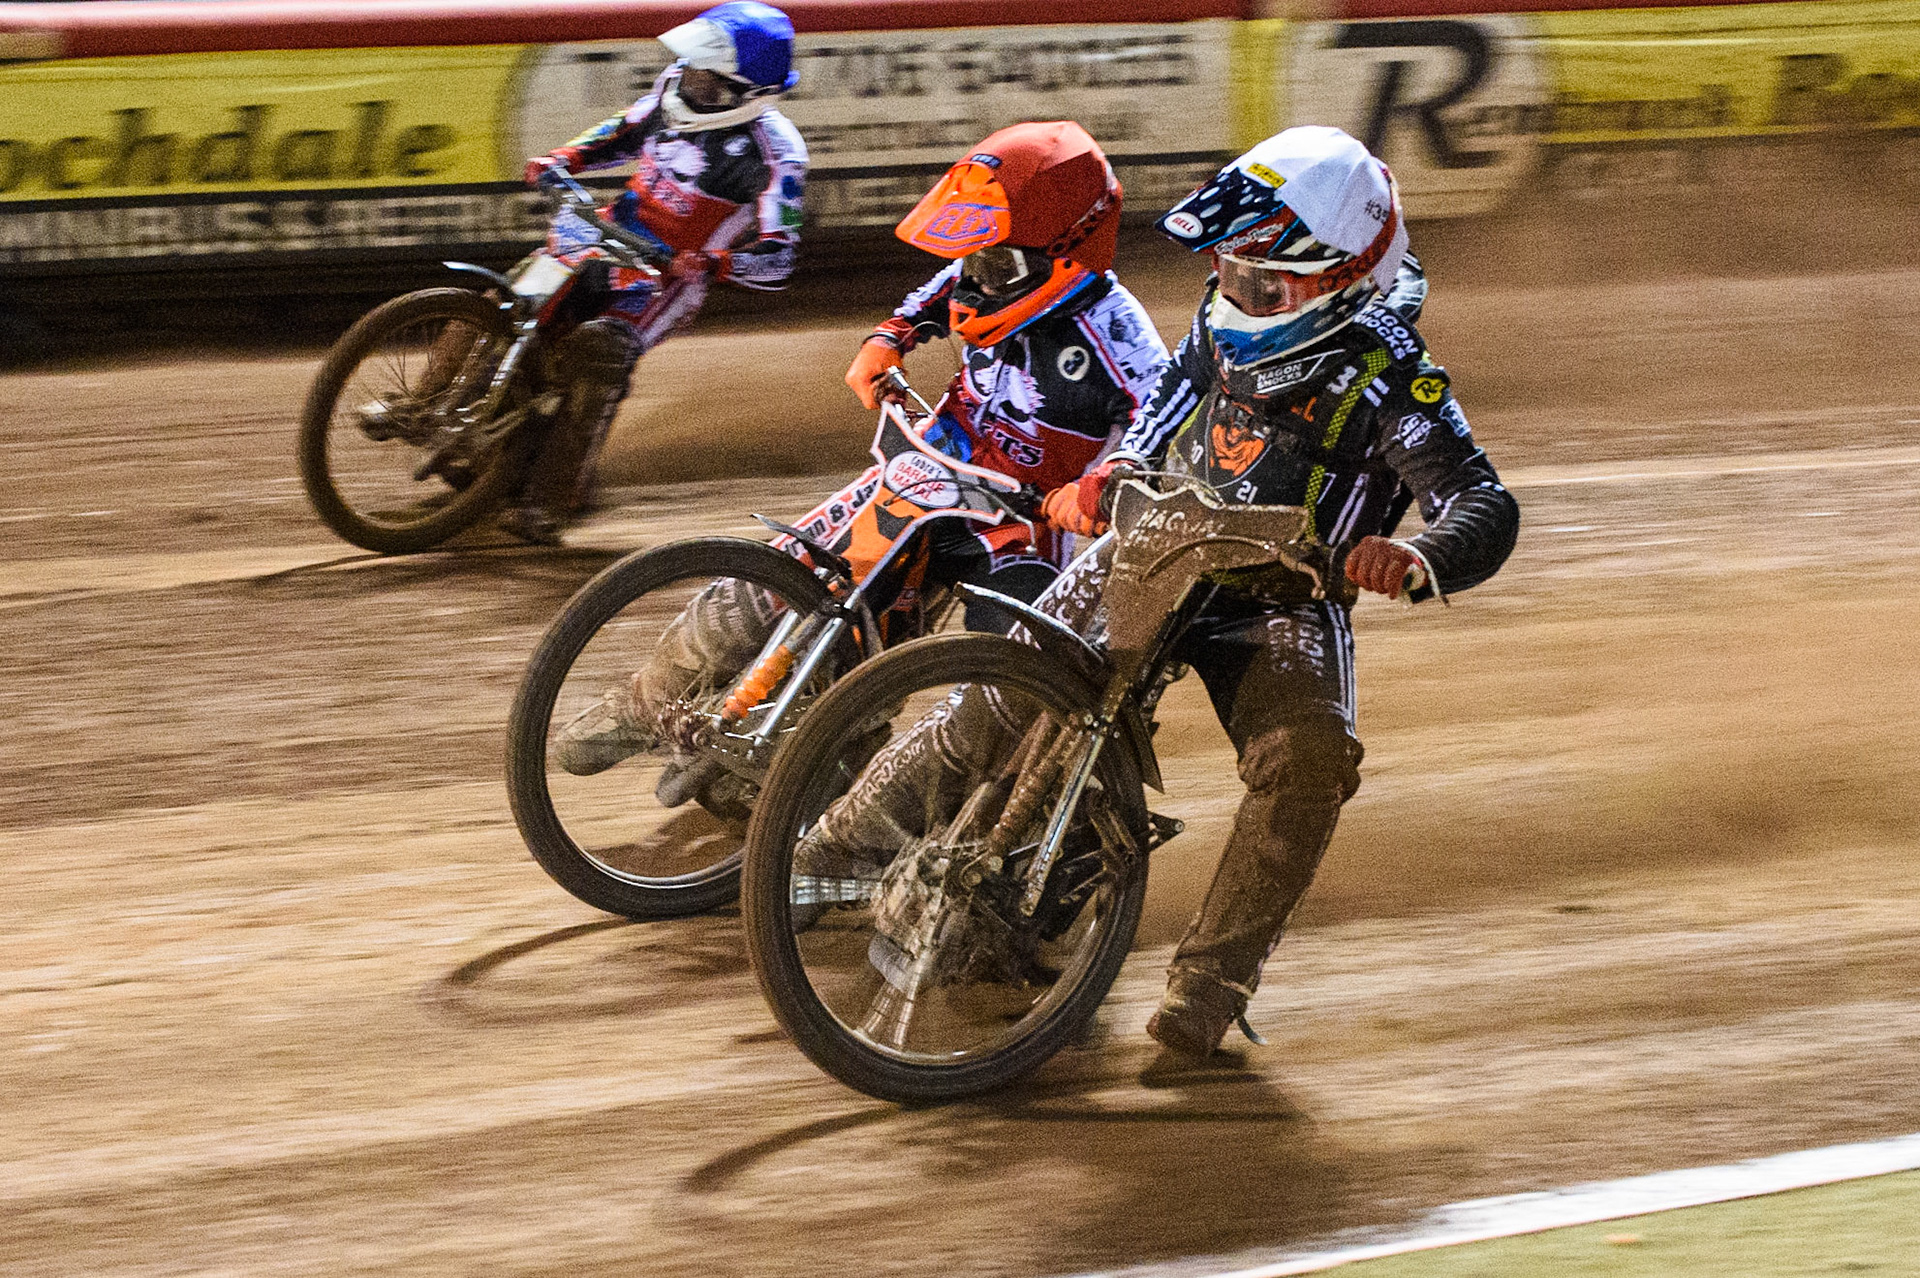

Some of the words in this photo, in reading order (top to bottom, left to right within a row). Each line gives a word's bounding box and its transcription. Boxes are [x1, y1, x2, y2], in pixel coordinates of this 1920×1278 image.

[1172, 215, 1195, 234] BELL
[1364, 304, 1419, 355] HAGON
[1257, 363, 1302, 381] HAGON
[1236, 481, 1259, 503] 21
